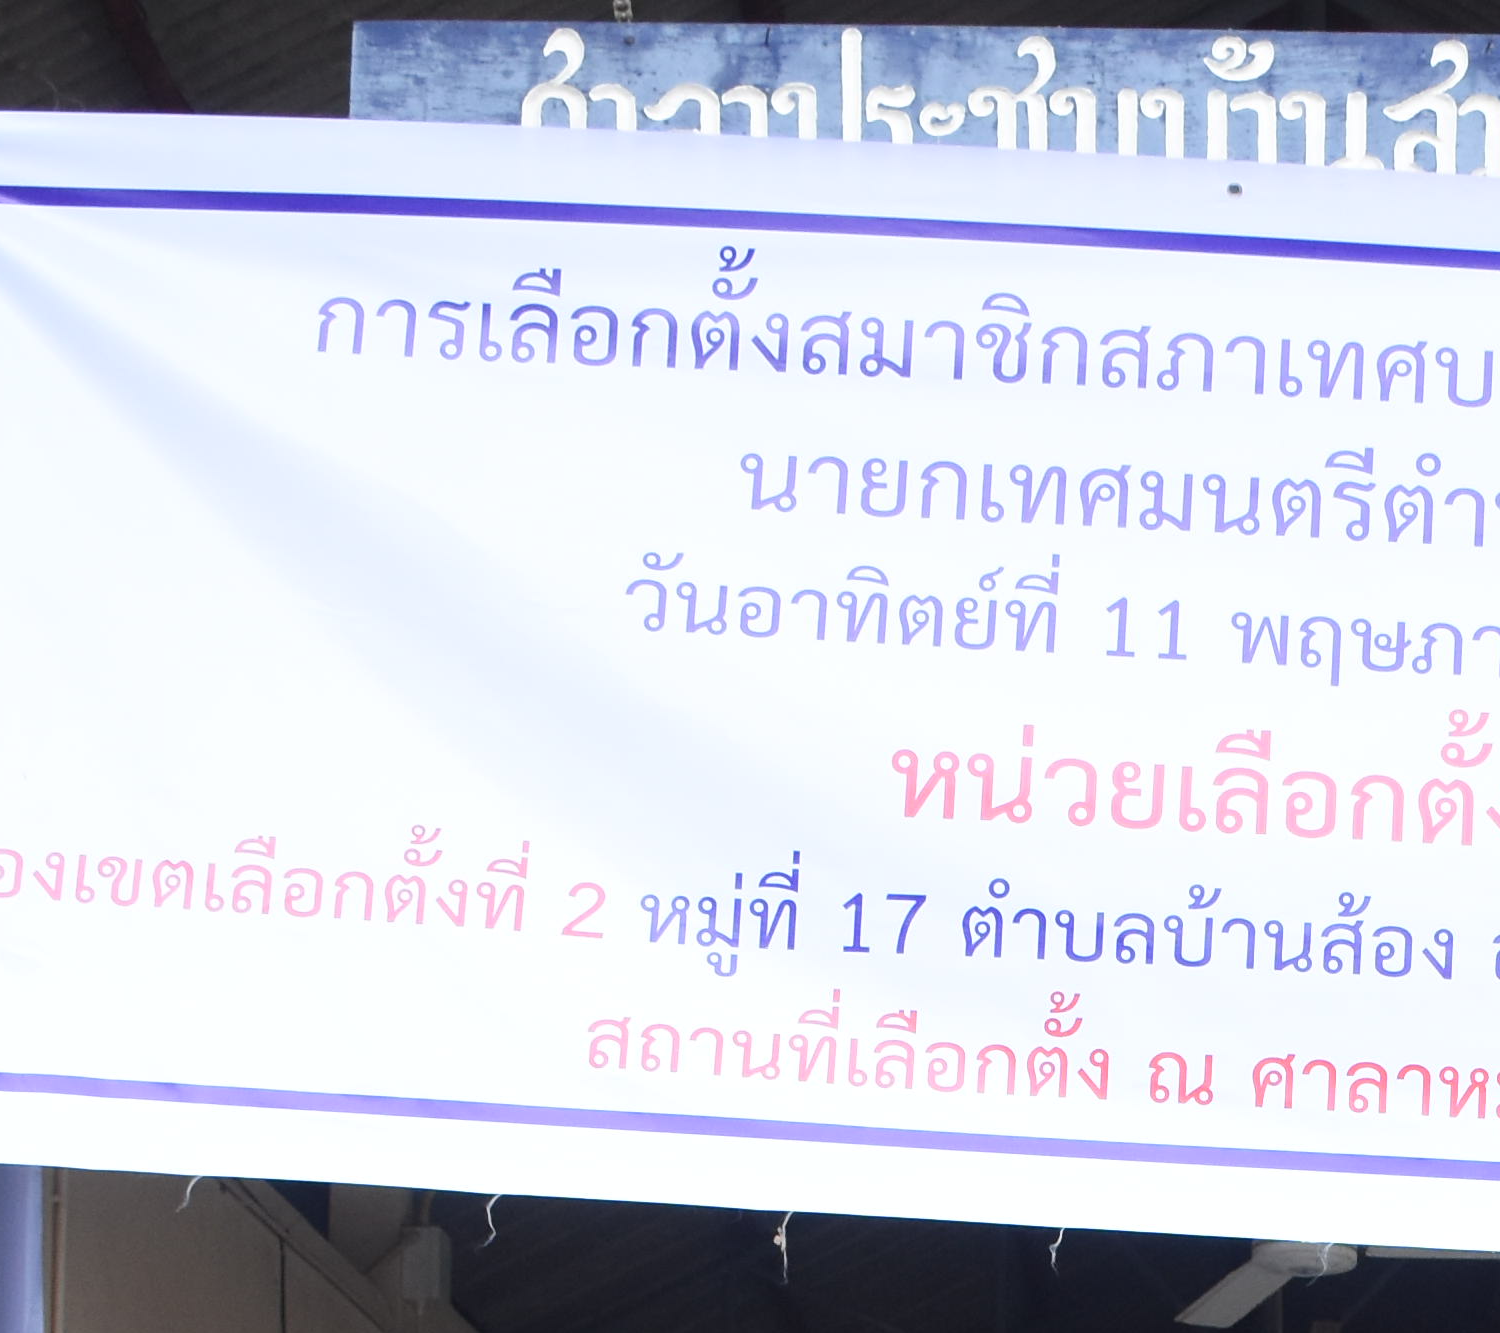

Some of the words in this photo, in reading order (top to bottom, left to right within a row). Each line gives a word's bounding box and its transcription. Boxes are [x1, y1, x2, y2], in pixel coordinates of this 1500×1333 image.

[625, 551, 1061, 654] วันอาทิตย์ที่
[1105, 596, 1188, 661] 11
[561, 881, 606, 939] 2
[639, 850, 801, 978] หมู่ที่
[841, 891, 928, 955] 17
[961, 877, 1454, 982] ตำบลบ้านส้อง
[586, 988, 1110, 1102] สถานที่เลือกตั้ง
[1148, 1051, 1214, 1106] ณ
